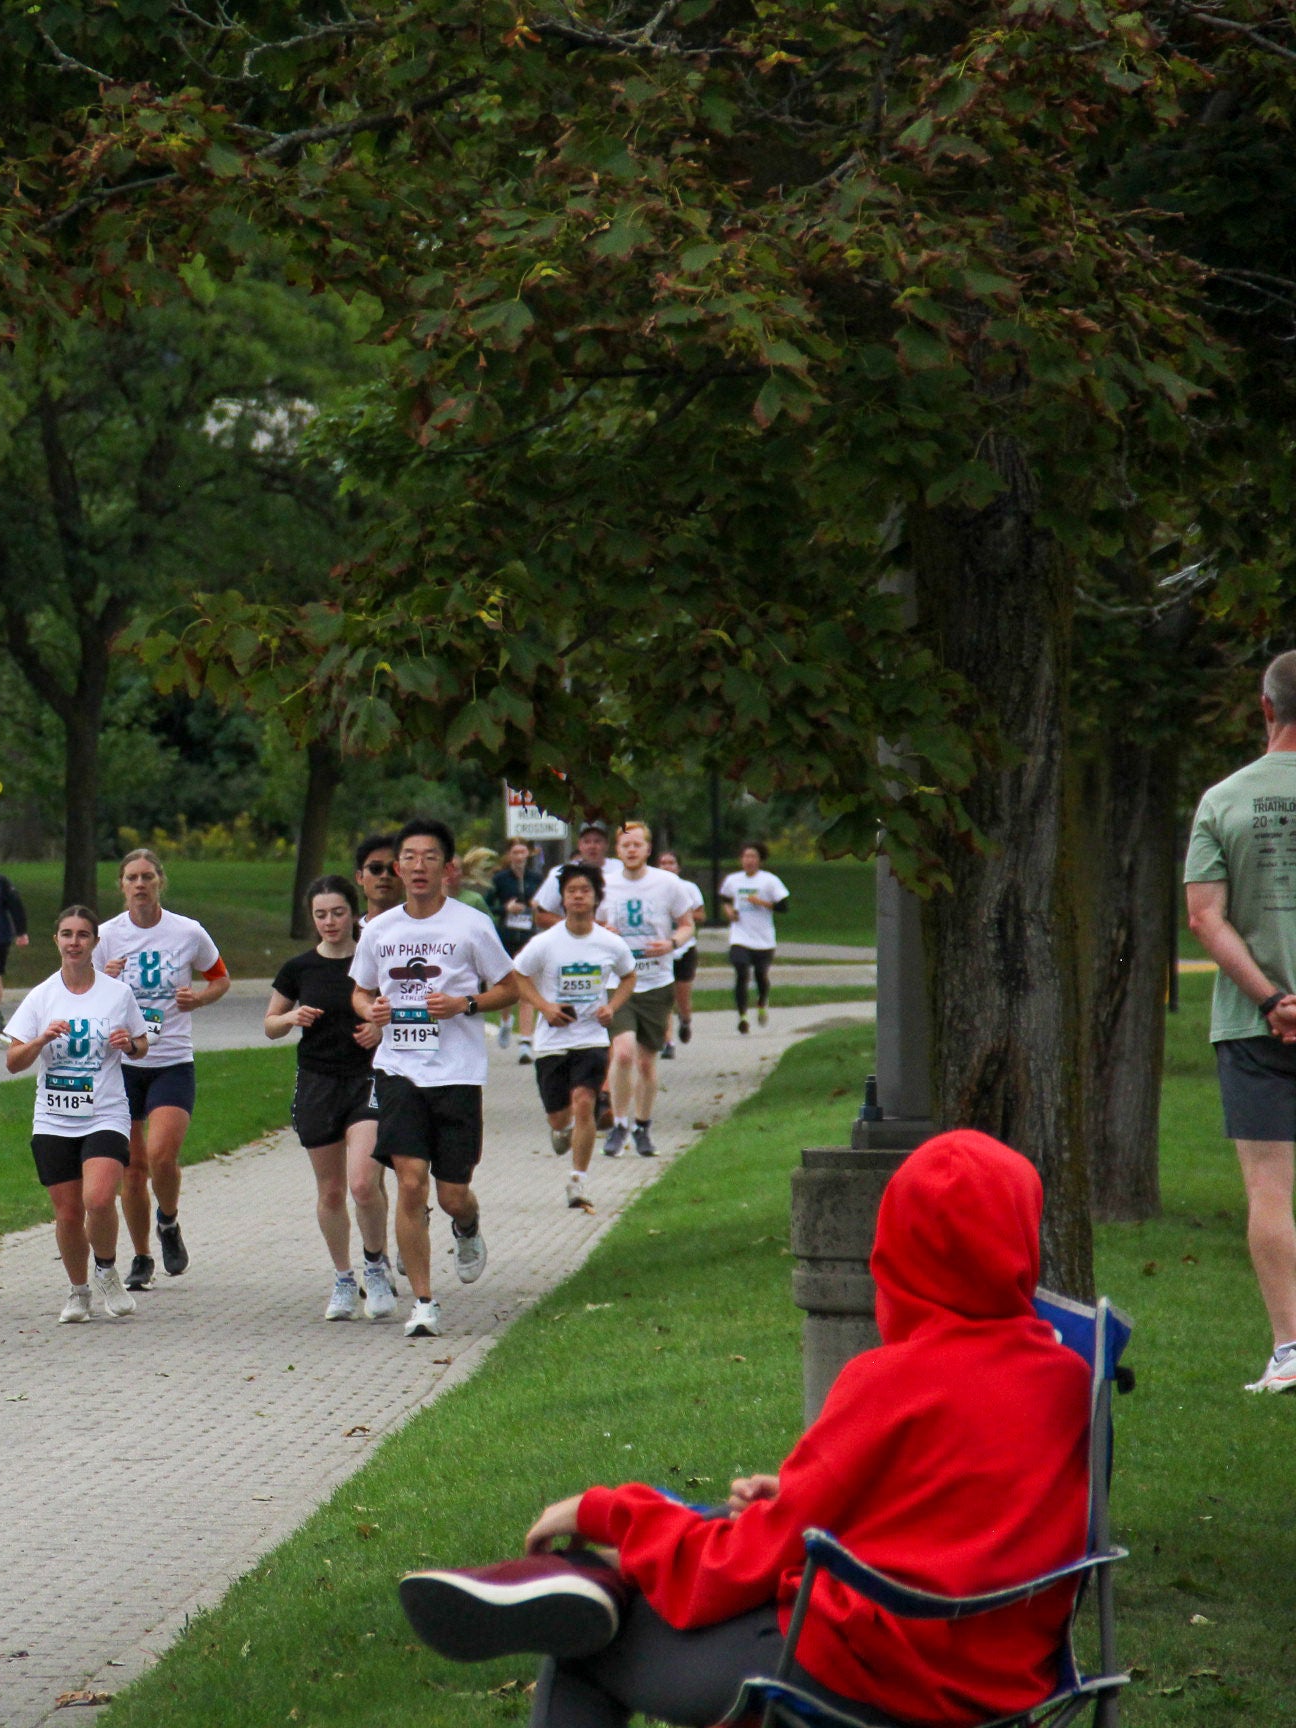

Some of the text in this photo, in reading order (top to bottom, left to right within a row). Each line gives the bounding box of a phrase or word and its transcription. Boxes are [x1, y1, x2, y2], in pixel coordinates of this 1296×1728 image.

[379, 943, 457, 957] UW PHARMACY
[563, 980, 592, 991] 2553
[393, 1028, 427, 1042] 5119
[47, 1094, 80, 1109] 5118
